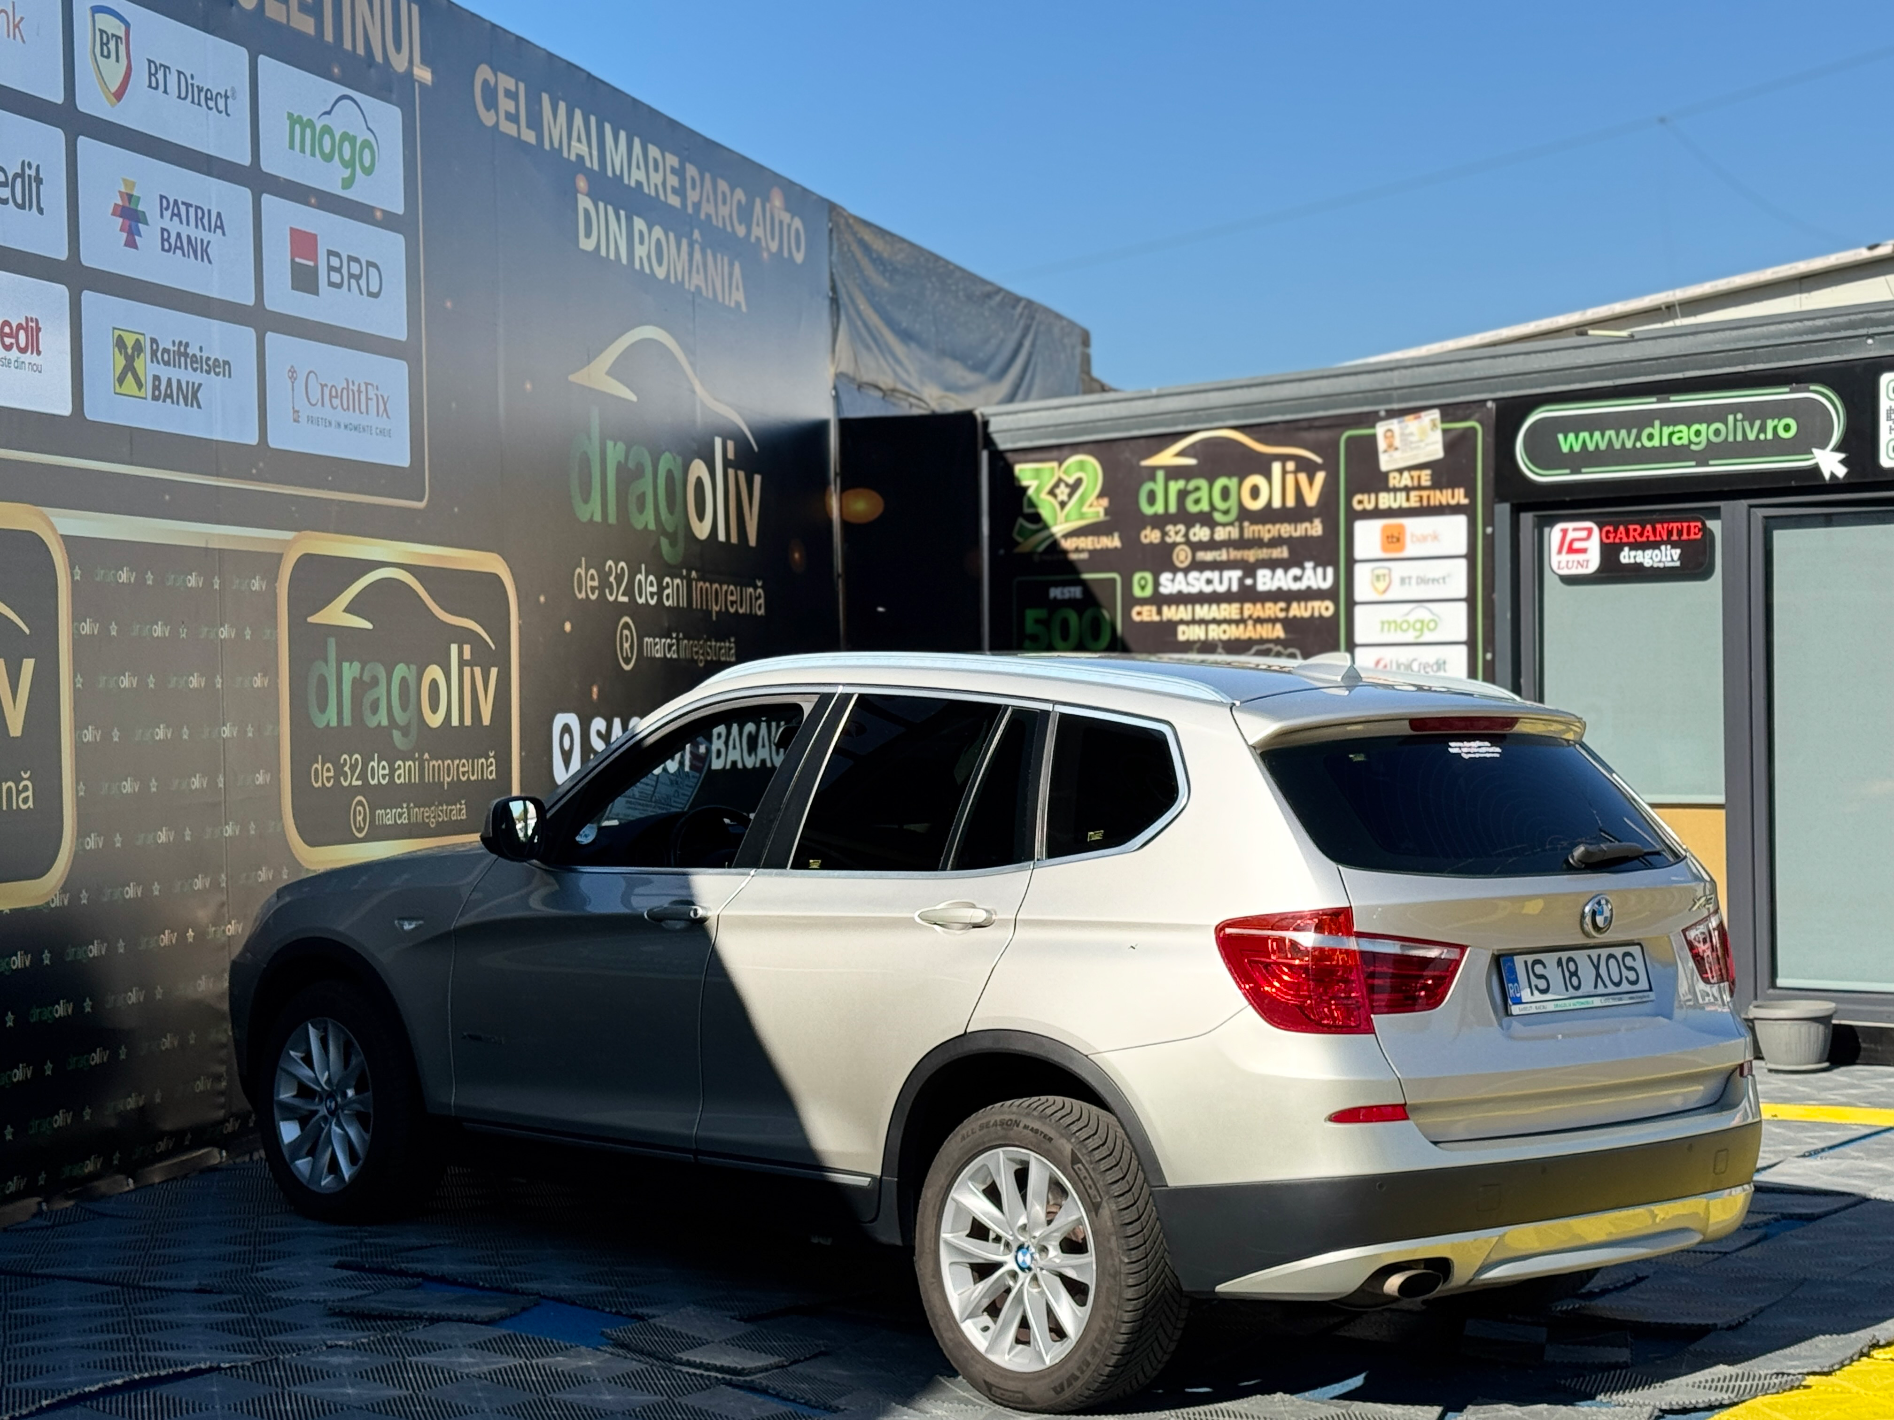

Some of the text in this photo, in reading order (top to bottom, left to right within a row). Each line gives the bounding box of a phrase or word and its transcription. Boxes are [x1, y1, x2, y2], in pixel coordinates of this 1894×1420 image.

[98, 27, 123, 63] BT
[146, 58, 171, 95] BT
[286, 111, 376, 190] mogo
[474, 63, 805, 265] CEL MAI MARE PARC AUTO
[159, 193, 226, 236] PATRIA
[159, 227, 213, 265] BANK
[577, 192, 747, 313] DIN ROMÂNIA
[326, 248, 383, 299] BRD
[13, 356, 26, 371] din
[27, 361, 42, 373] nou
[149, 336, 232, 379] Raiffeisen
[151, 374, 203, 410] BANK
[305, 370, 391, 420] CreditFix
[306, 415, 332, 428] PRIETEN
[343, 422, 373, 436] MOMENTE
[375, 426, 392, 438] CHEIE
[1557, 413, 1798, 455] www.dragoliv.ro
[569, 405, 762, 565] dragoliv
[1138, 461, 1326, 523] dragoliv
[1388, 469, 1432, 488] RATE
[1352, 488, 1470, 511] CU BULETINUL
[1140, 518, 1323, 544] de 32 de ani împreună
[1386, 531, 1440, 545] tbi bank
[1556, 526, 1594, 556] 12
[1601, 521, 1703, 544] GARANTIE
[1195, 547, 1227, 562] marcă
[1557, 560, 1590, 570] LUNI
[1619, 545, 1682, 567] dragoliv
[574, 557, 765, 621] de 32 de ani împreună
[1049, 586, 1084, 600] PESTE
[1158, 570, 1243, 595] SASCUT
[1256, 562, 1335, 592] BACĂU
[1374, 574, 1387, 583] BT
[1400, 576, 1413, 586] BT
[1131, 600, 1335, 623] CEL MAI MARE PARC AUTO
[1023, 607, 1112, 651] 500
[1177, 622, 1285, 641] DIN ROMÂNIA
[1380, 618, 1439, 640] mogo
[643, 632, 677, 661] marcă
[678, 632, 736, 667] înregistrată
[307, 637, 498, 751] dragoliv
[311, 749, 497, 789] de 32 de ani împreună
[375, 802, 408, 825] marcă
[409, 801, 467, 827] înregistrată
[1524, 951, 1641, 996] IS 18 XOS
[1509, 982, 1521, 999] RO
[960, 1118, 1054, 1143] ALL SEASON MASTER
